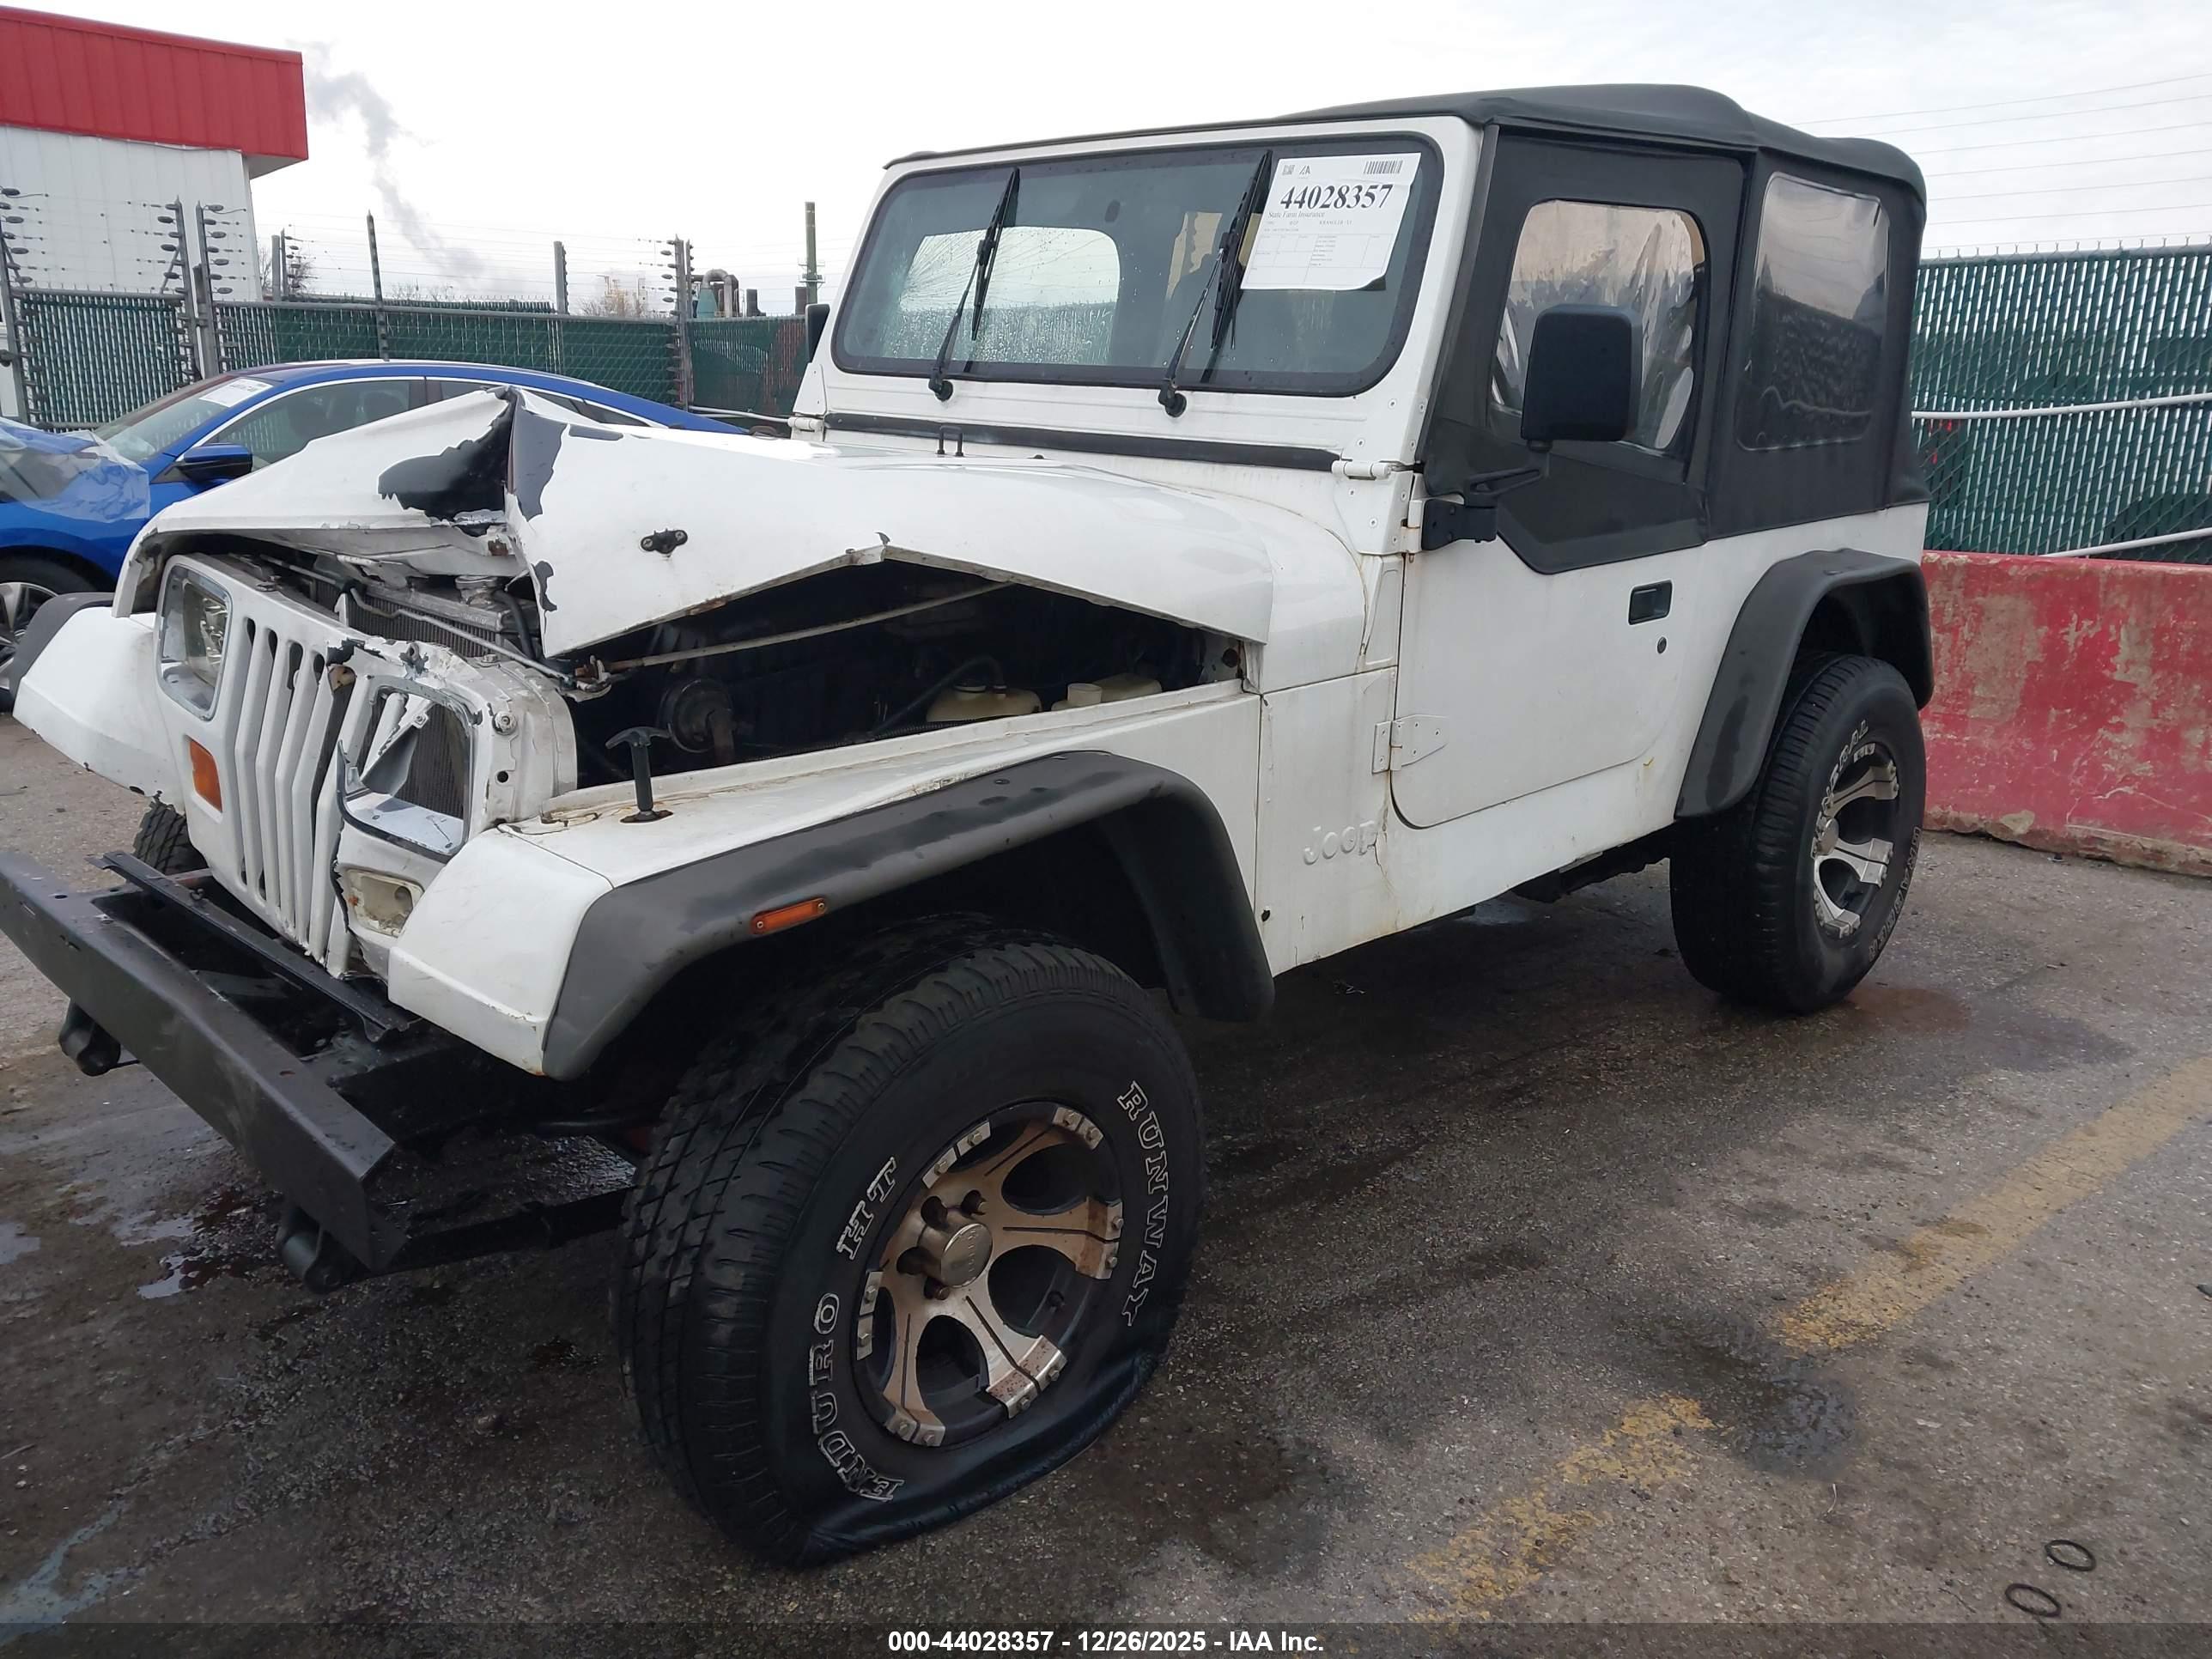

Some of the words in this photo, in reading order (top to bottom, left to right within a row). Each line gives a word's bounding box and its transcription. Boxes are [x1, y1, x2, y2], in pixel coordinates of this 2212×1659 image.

[1280, 184, 1394, 210] 44028357
[836, 1156, 897, 1261] HT
[1117, 1080, 1170, 1327] RUNWAY
[809, 1292, 905, 1503] ENDURO
